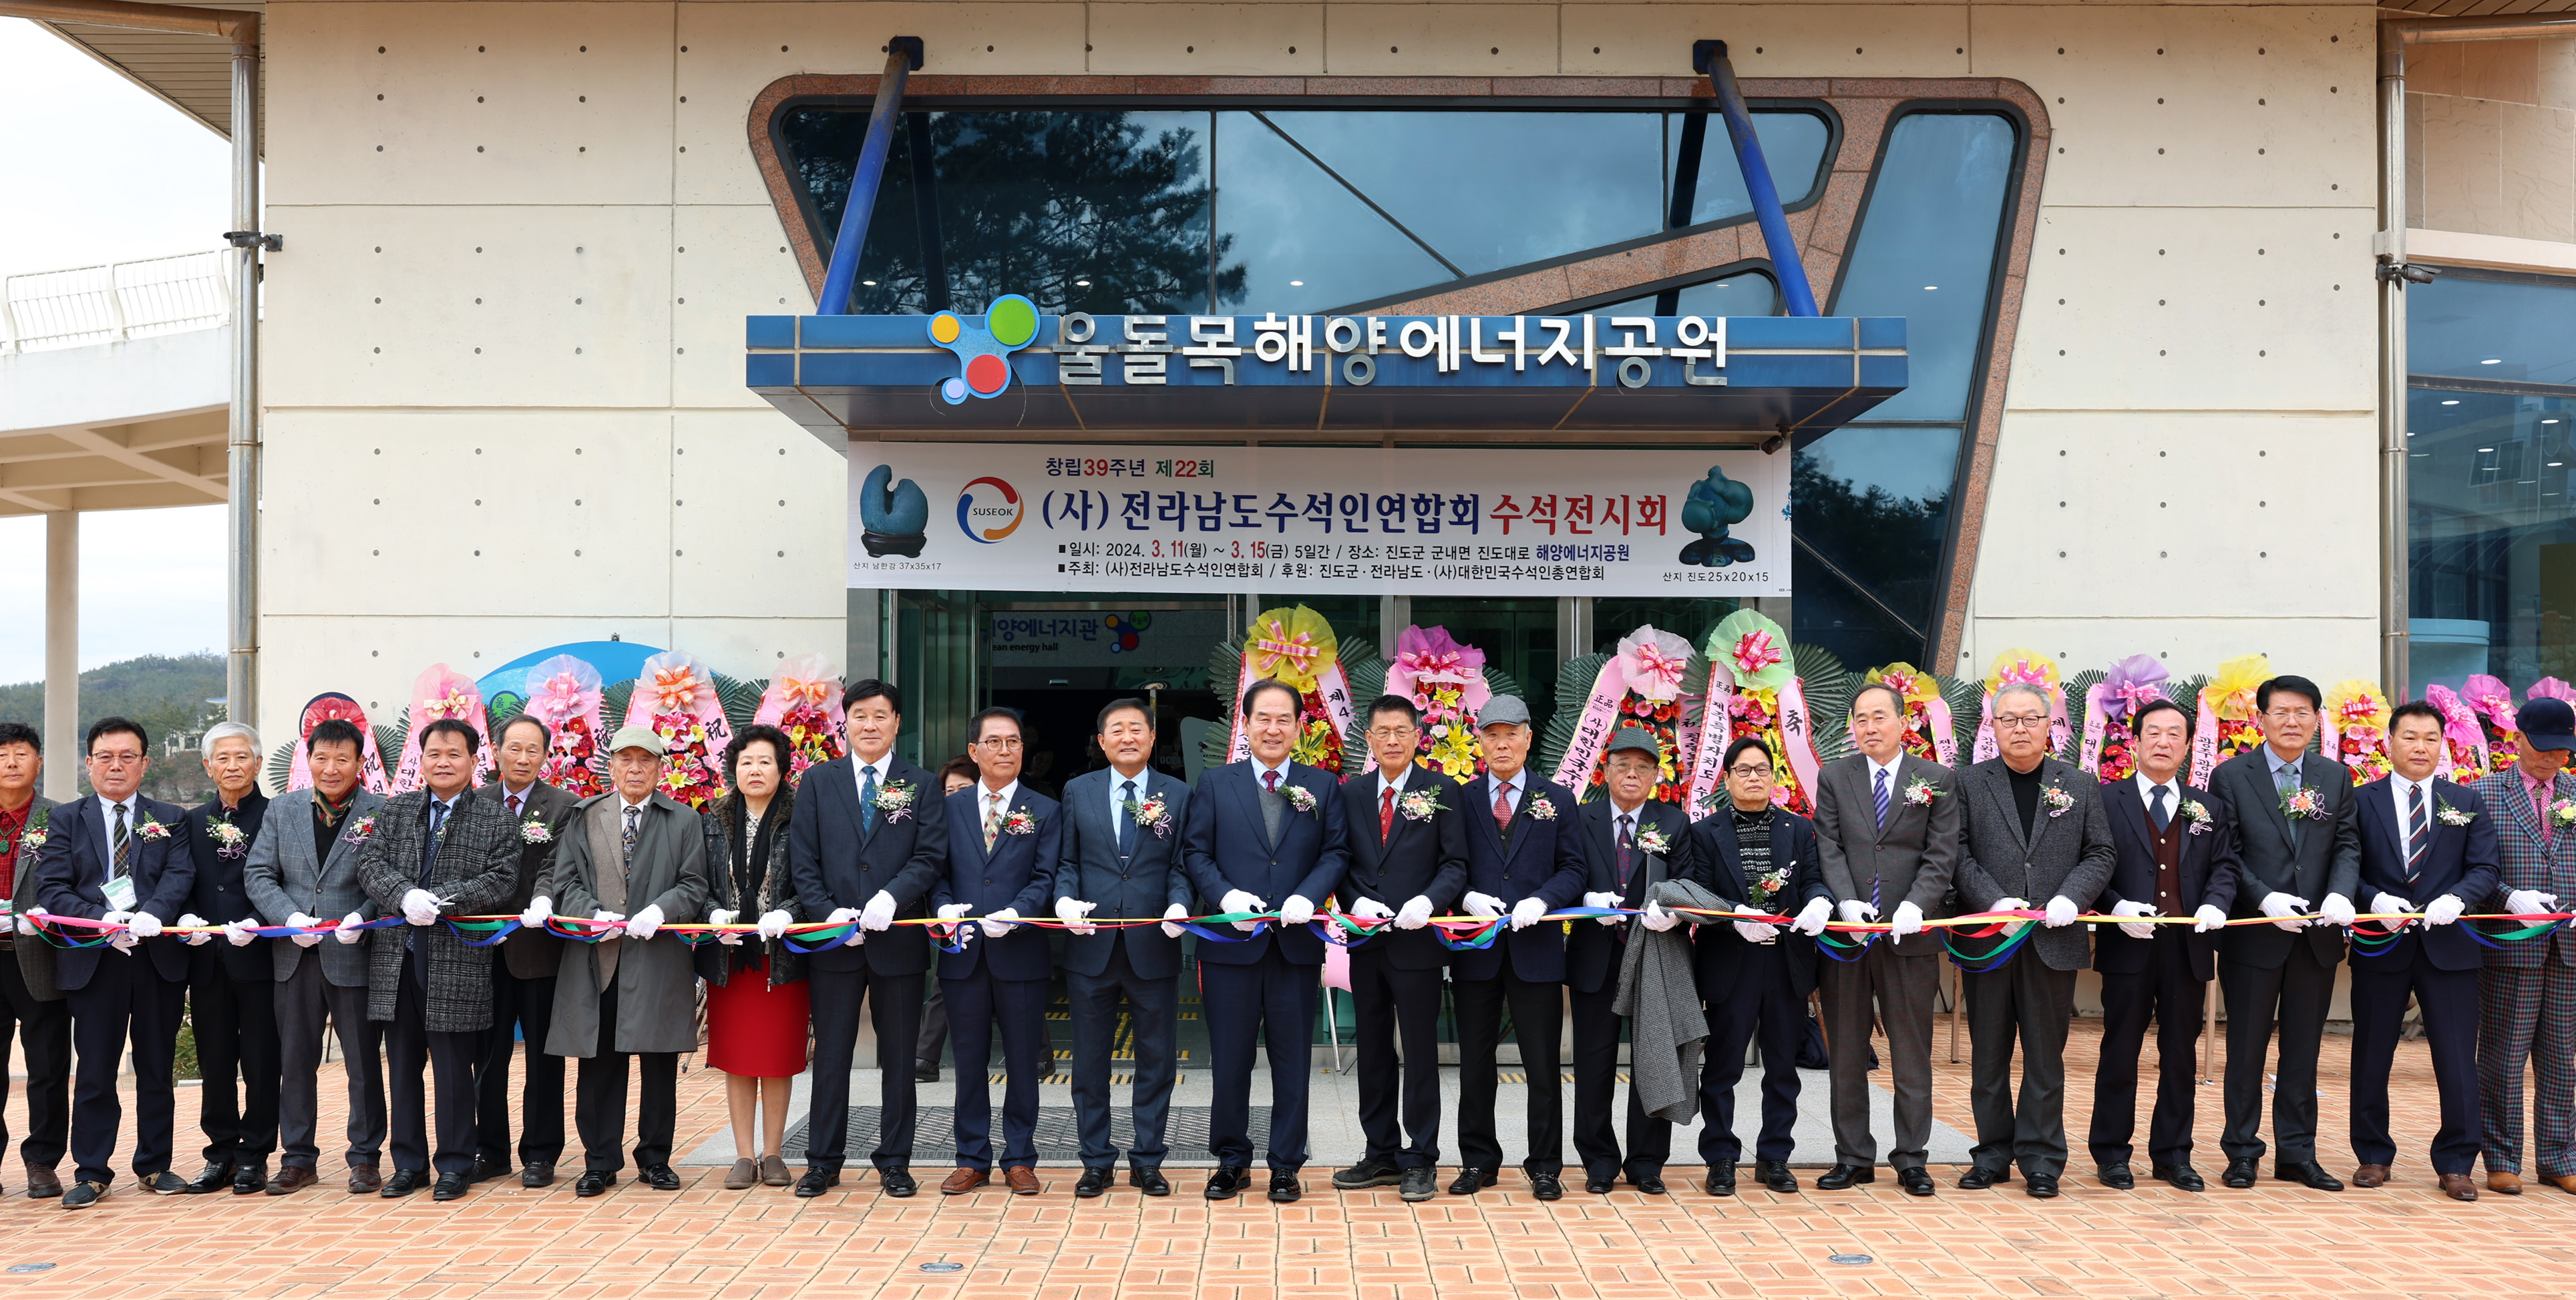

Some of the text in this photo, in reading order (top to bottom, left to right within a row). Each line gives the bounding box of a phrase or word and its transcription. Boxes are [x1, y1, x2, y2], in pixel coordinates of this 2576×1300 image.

[1053, 312, 1728, 389] 울돌목해양에너지공원
[1047, 458, 1214, 478] 창립39주년 제22회
[973, 507, 1013, 516] SUSEOK
[1042, 489, 1666, 535] (사) 전라남도수석인연합회 수석전시회
[1069, 541, 1100, 556] 일시:
[1106, 543, 1145, 557] 2024.
[1151, 539, 1165, 558] 3.
[1231, 540, 1244, 559] 3.
[1294, 544, 1330, 559] 5일간
[1348, 545, 1379, 560] 장소:
[1385, 546, 1425, 560] 진도군
[1431, 546, 1471, 561] 군내면
[1477, 546, 1531, 561] 진도대로
[1536, 544, 1630, 562] 해양에너지공원
[854, 562, 869, 570] 산지
[872, 562, 896, 570] 남한강
[1068, 561, 1099, 575] 주최:
[1281, 564, 1313, 578] 후원:
[1662, 572, 1682, 582] 산지
[1009, 644, 1040, 653] energy
[1042, 642, 1058, 651] hall
[705, 717, 727, 741] 祝
[1785, 709, 1803, 737] 축
